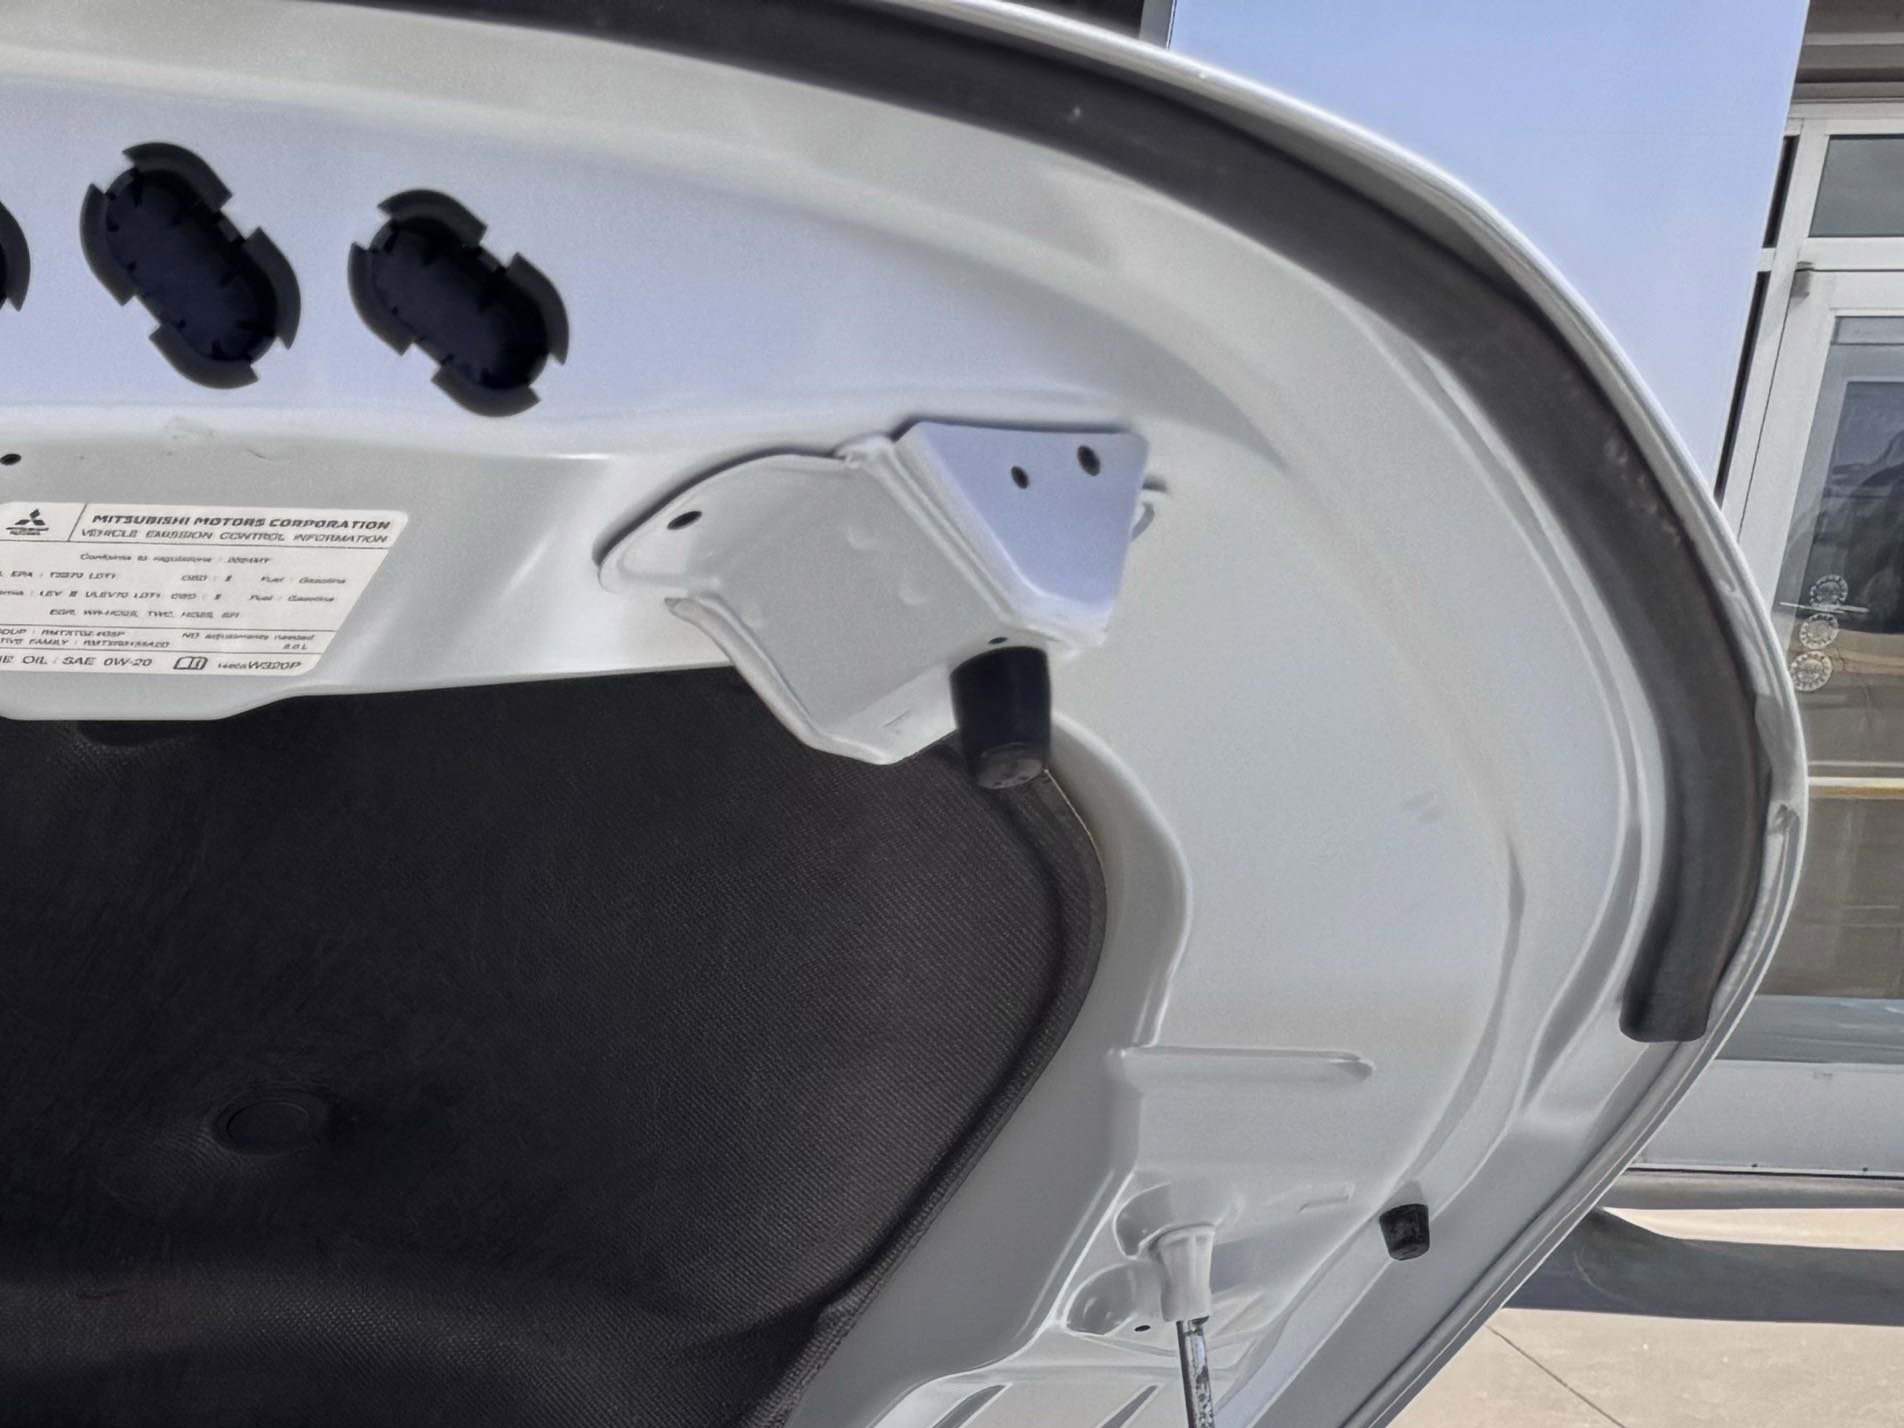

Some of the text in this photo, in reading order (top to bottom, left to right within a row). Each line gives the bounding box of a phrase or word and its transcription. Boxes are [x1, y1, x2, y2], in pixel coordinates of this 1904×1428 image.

[92, 514, 391, 530] MITSUBISHI MOTORS CORPORATION
[81, 529, 138, 538] VEHICLE
[219, 532, 285, 542] CONTROL
[292, 533, 388, 544] INFORMATION
[22, 655, 48, 665] OIL
[62, 656, 96, 666] SAE
[103, 657, 152, 667] 0W-20
